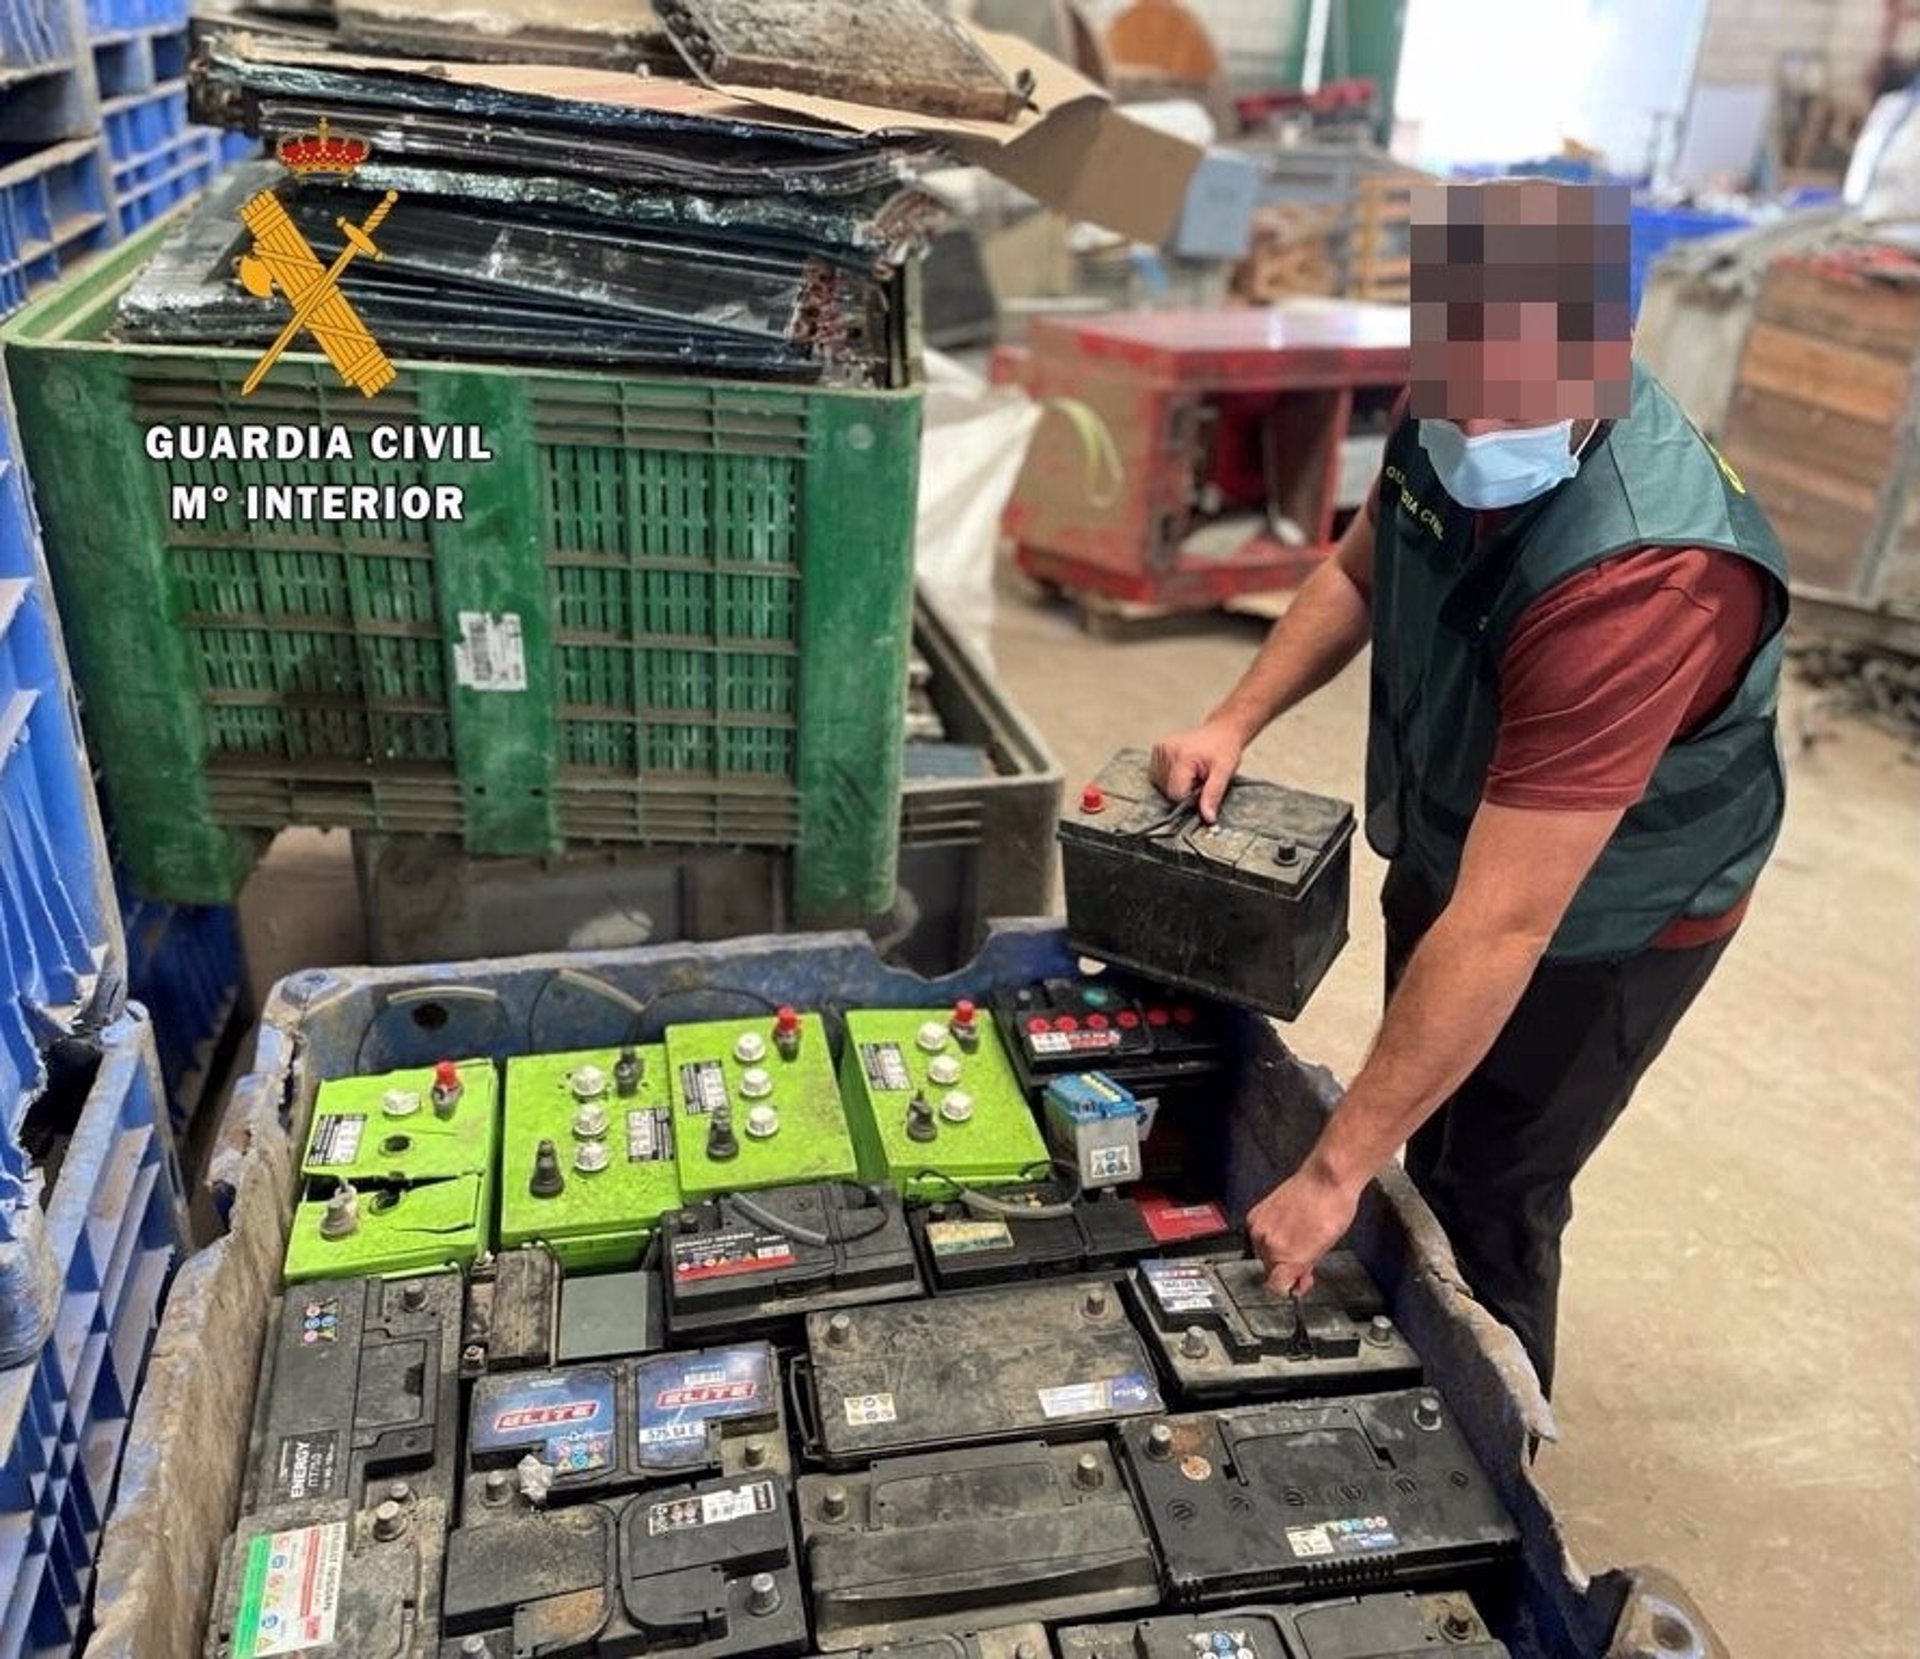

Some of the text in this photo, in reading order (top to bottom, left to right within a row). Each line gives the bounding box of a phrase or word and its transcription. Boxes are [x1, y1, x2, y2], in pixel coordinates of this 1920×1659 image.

[660, 1382, 756, 1407] ELITE
[499, 1402, 597, 1430] ELITE
[290, 1441, 310, 1498] ENERGY
